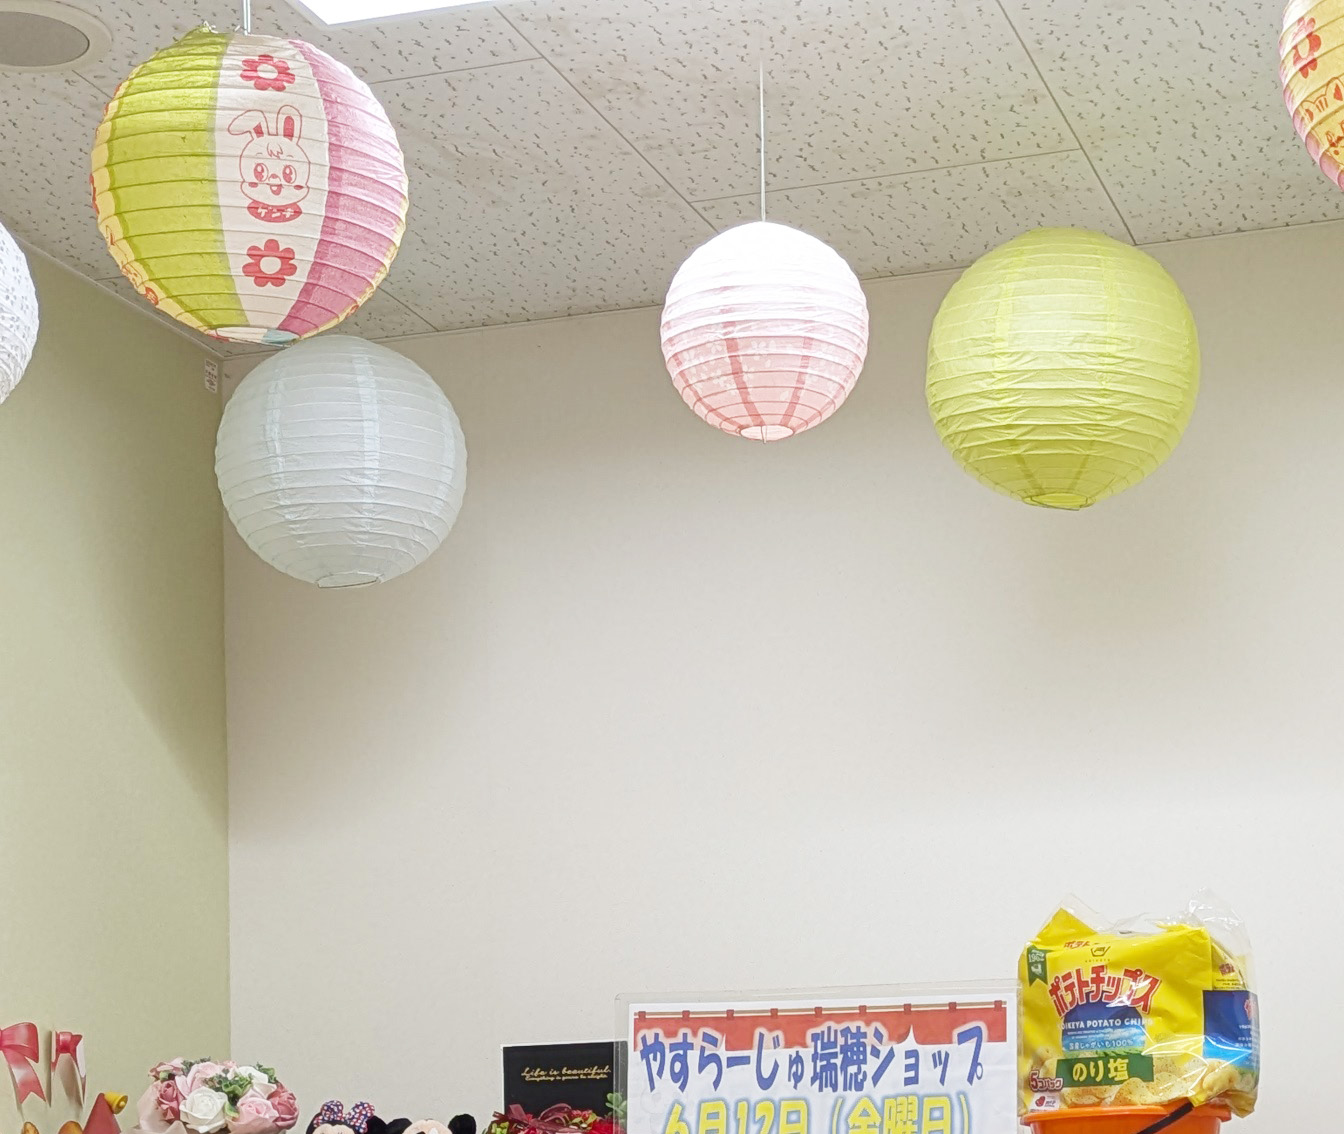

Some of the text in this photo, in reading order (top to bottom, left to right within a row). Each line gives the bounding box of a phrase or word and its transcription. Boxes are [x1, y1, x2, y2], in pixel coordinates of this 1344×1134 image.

[1048, 964, 1161, 1017] ポテトチップス
[1058, 1020, 1085, 1030] OIKEYA
[1086, 1018, 1122, 1028] POTATO
[639, 1024, 985, 1094] やすらーじゅ瑞穂ショップ
[1072, 1058, 1130, 1083] のり塩
